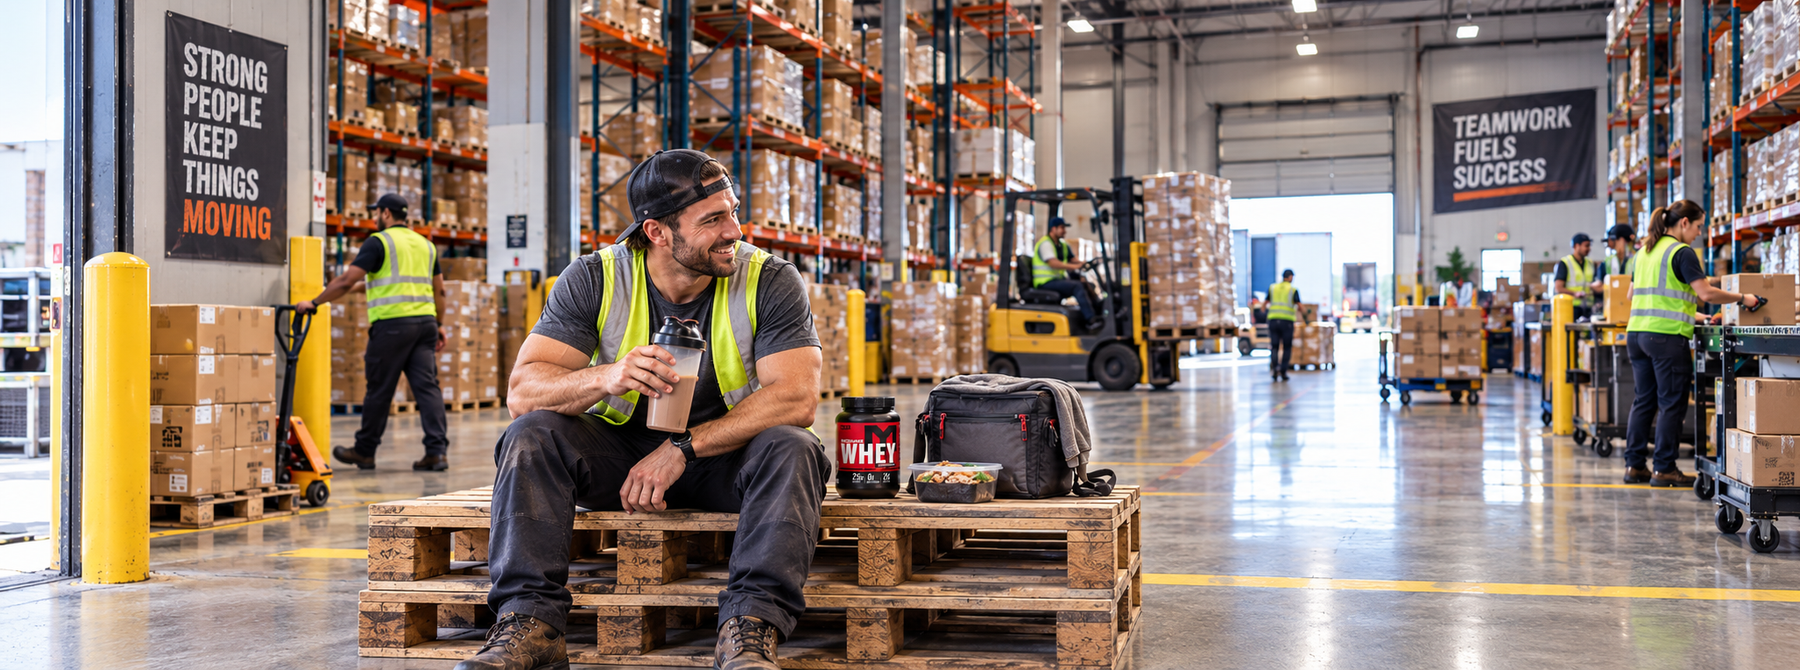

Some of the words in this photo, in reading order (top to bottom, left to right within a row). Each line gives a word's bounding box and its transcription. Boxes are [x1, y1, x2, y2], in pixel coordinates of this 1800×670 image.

[183, 42, 268, 94] STRONG
[183, 81, 262, 129] PEOPLE
[1453, 104, 1572, 139] TEAMWORK
[183, 120, 238, 160] KEEP
[1453, 135, 1517, 164] FUELS
[182, 159, 259, 201] THINGS
[1453, 157, 1547, 190] SUCCESS
[183, 198, 271, 240] MOVING
[841, 443, 896, 464] WHEY
